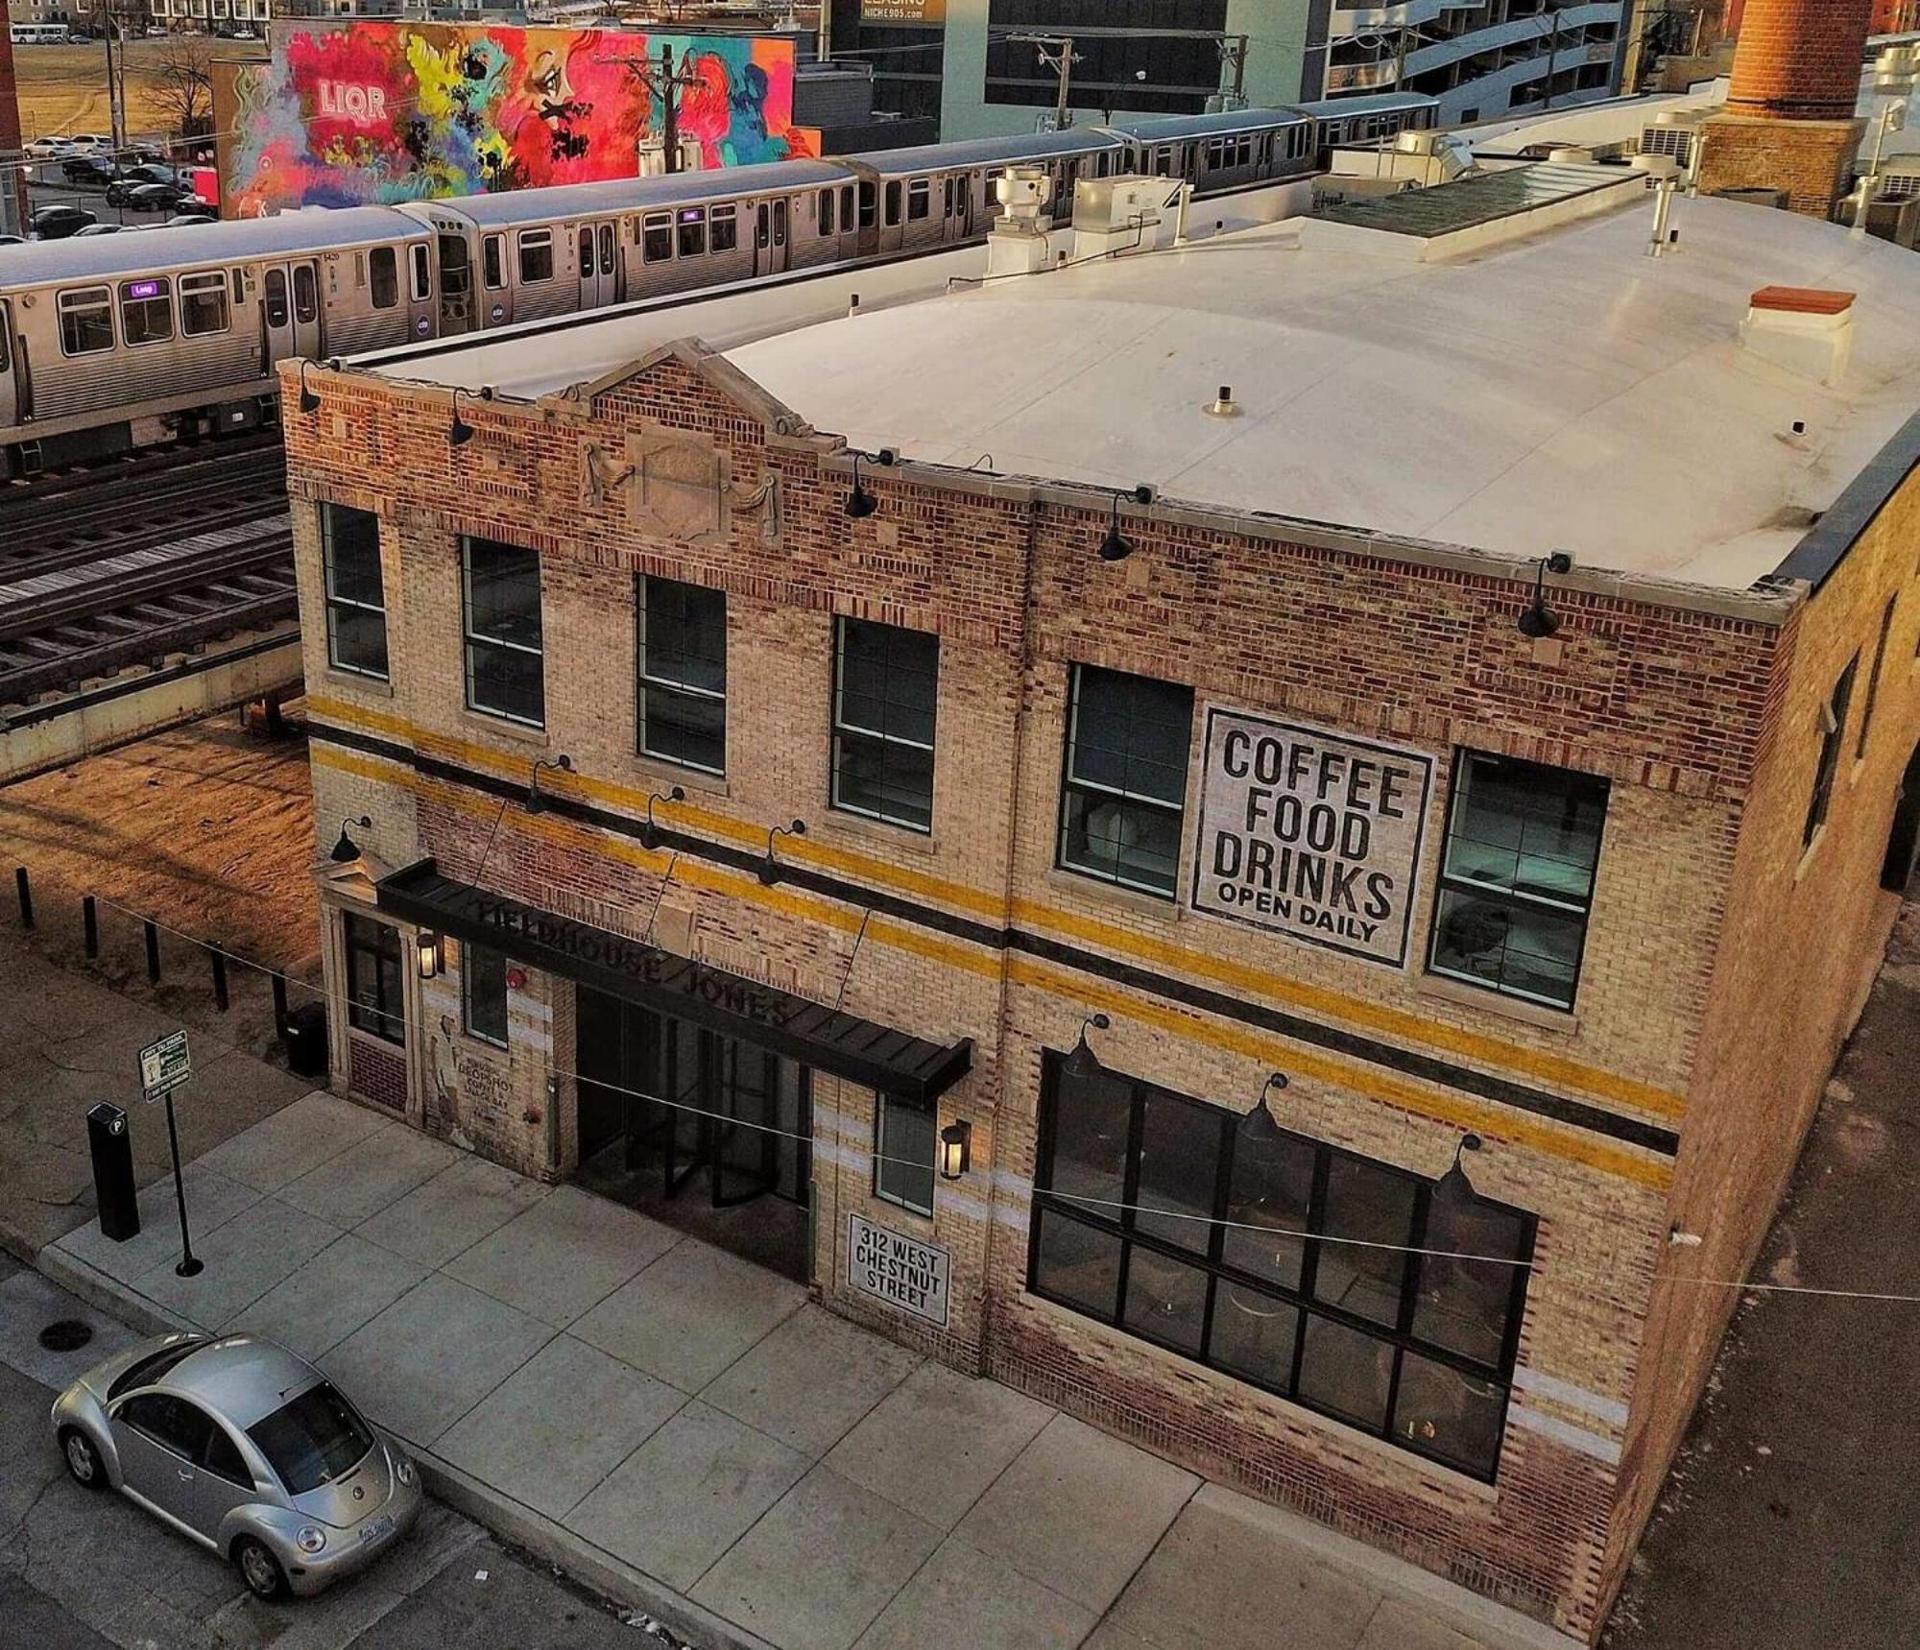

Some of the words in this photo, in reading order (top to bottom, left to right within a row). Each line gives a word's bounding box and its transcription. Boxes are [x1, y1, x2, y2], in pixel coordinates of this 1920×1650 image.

[864, 7, 923, 19] NICHE905.com
[319, 79, 388, 124] LIQR
[1223, 730, 1410, 819] COFFEE
[1246, 786, 1371, 861] FOOD
[1213, 830, 1394, 920] DRINKS
[1218, 882, 1292, 919] OPEN
[1300, 905, 1379, 943] DAILY
[685, 964, 788, 1025] JONES
[857, 1245, 941, 1294] CHESTNUT
[861, 1227, 888, 1253] 312
[893, 1239, 938, 1273] WEST
[867, 1270, 927, 1309] STREET
